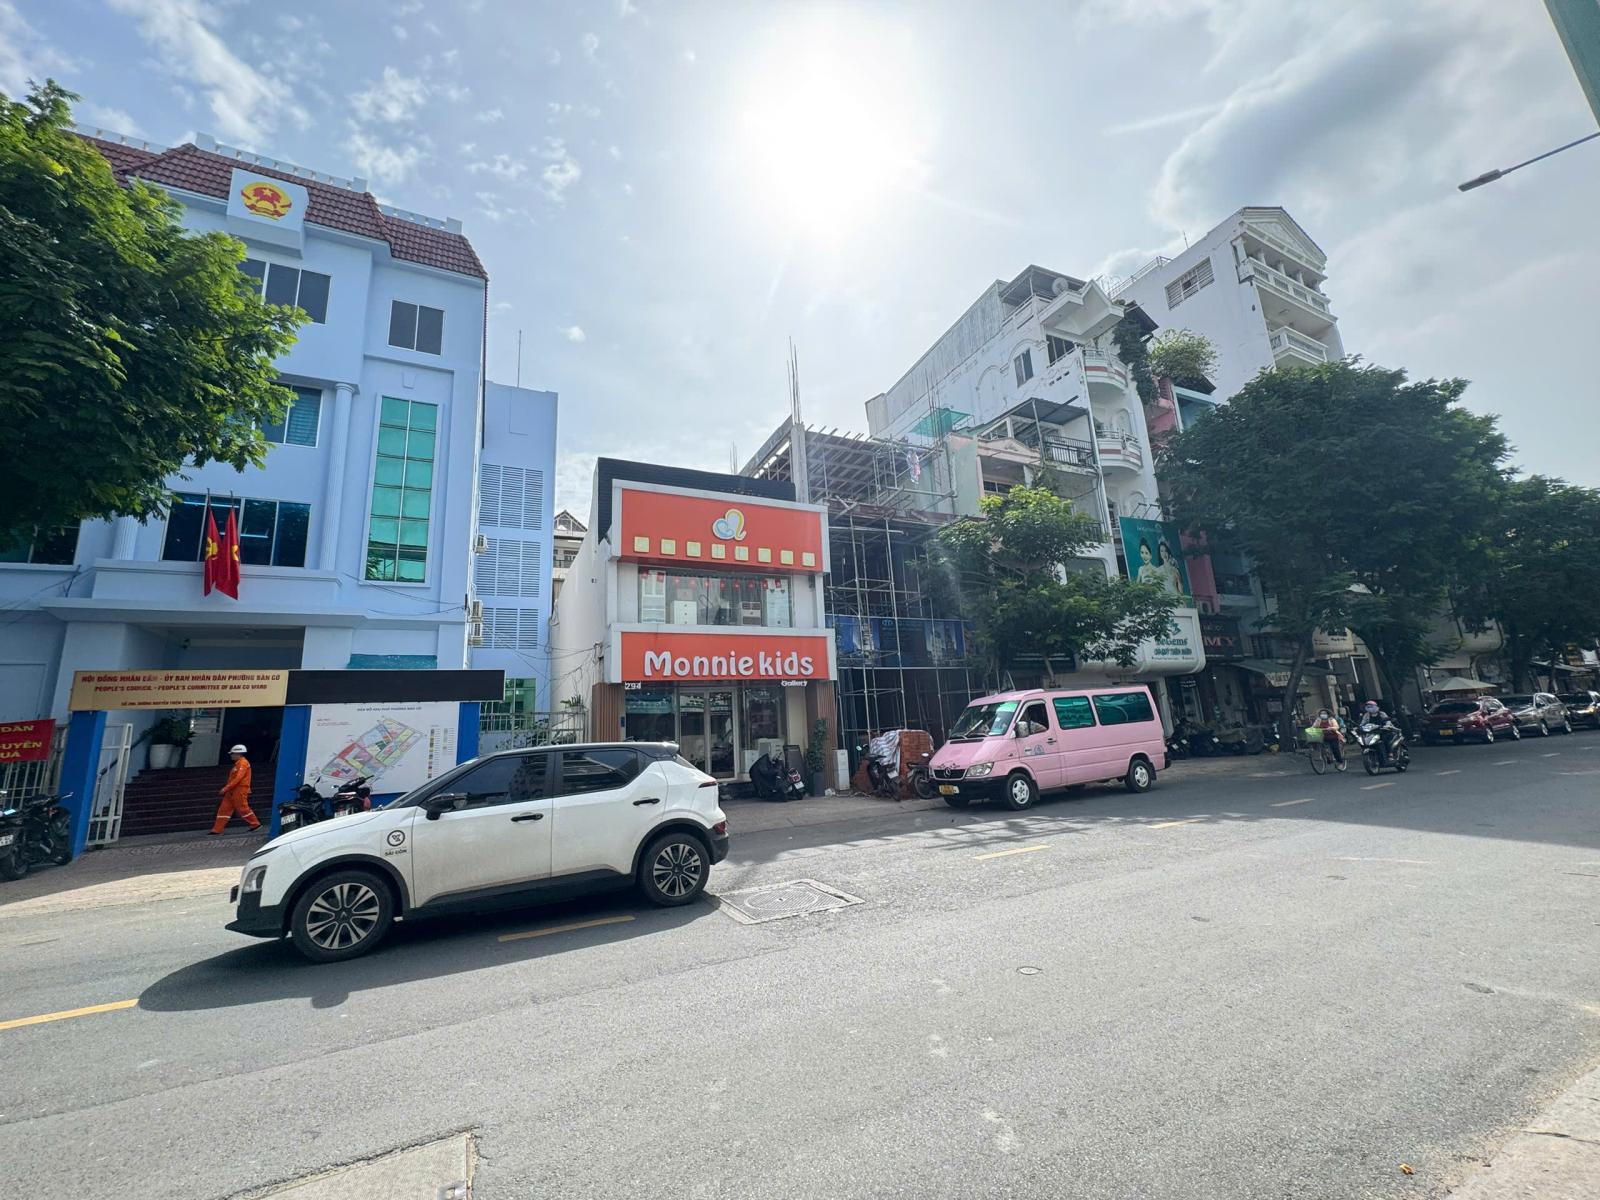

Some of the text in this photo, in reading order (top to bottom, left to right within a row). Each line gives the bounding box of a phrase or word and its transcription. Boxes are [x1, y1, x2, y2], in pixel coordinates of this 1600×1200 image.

[643, 651, 815, 677] Monnie kids
[175, 674, 190, 682] BAN
